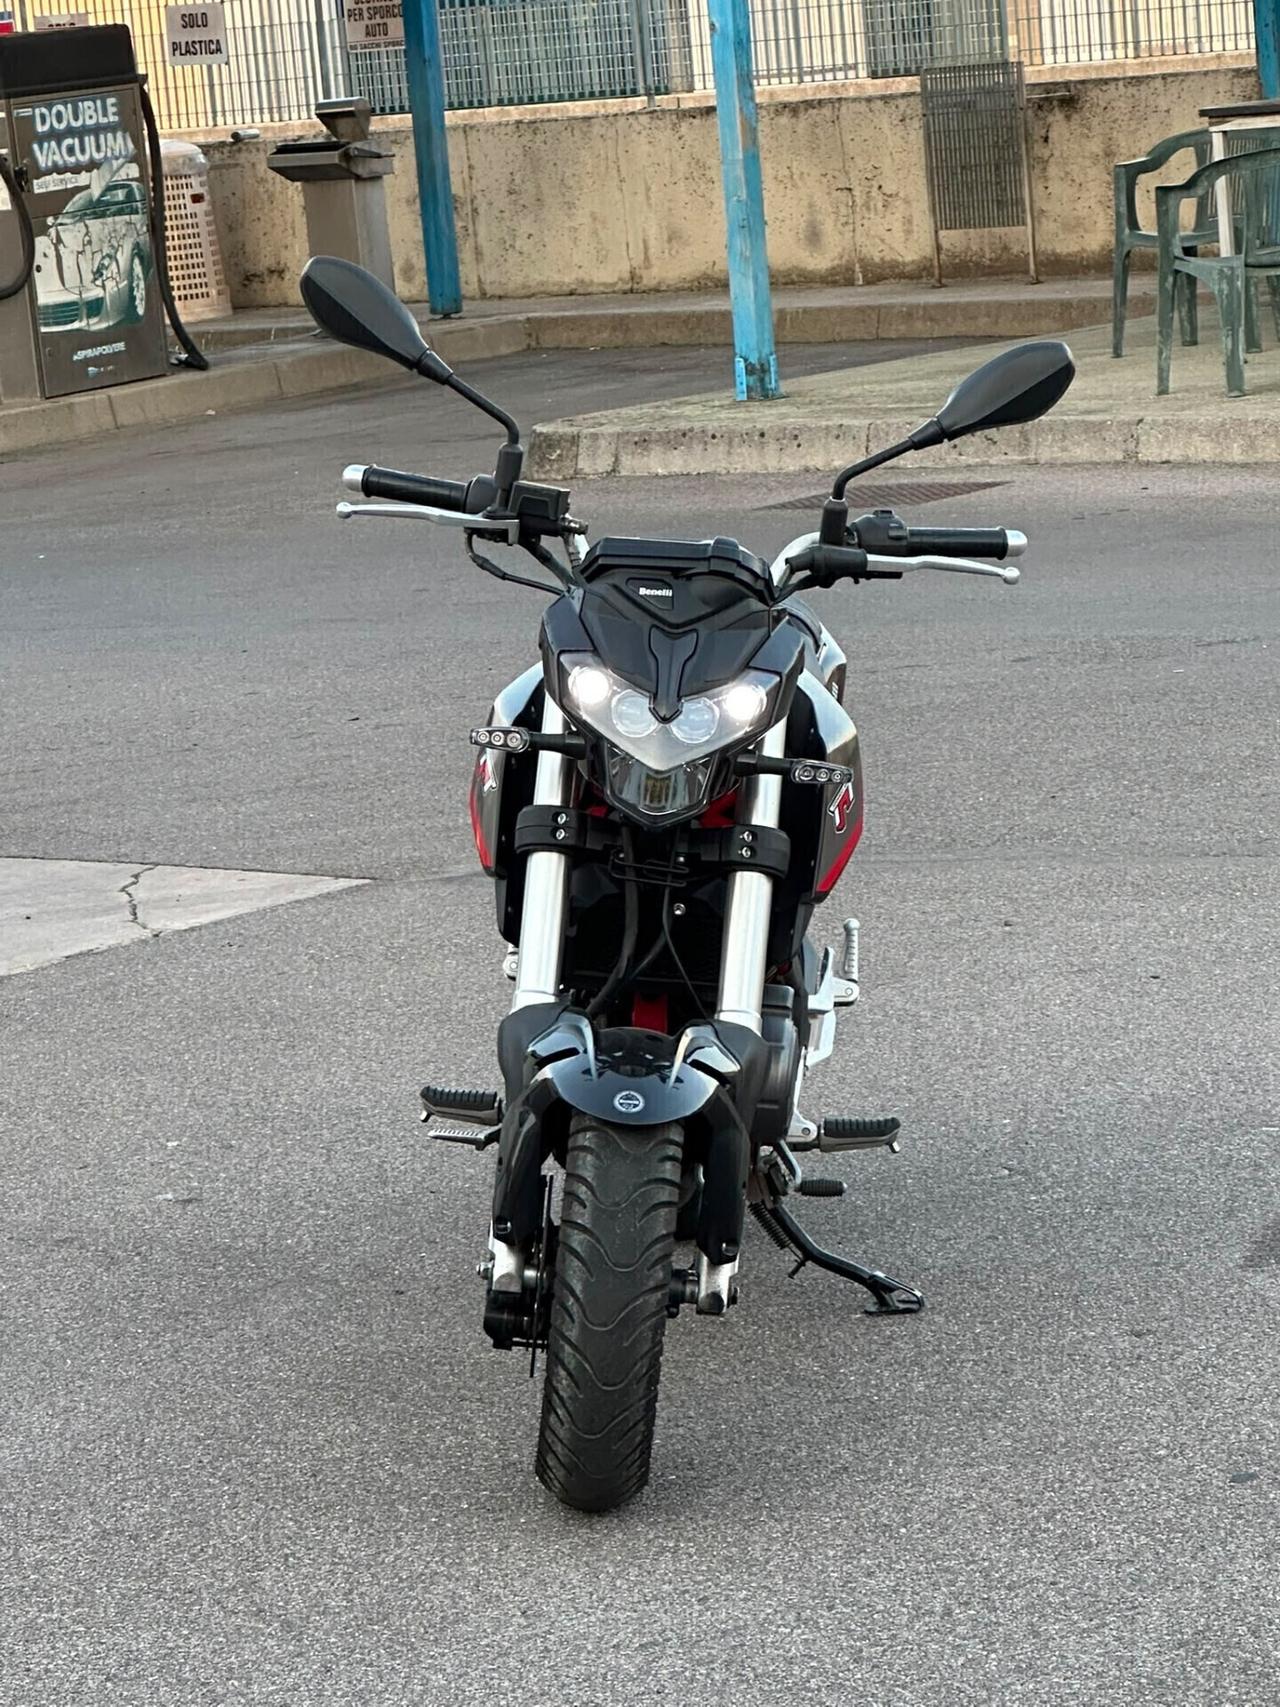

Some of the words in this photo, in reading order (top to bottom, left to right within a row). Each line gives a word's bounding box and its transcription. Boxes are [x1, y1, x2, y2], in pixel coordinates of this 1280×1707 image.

[181, 12, 208, 29] SOLO
[347, 8, 364, 22] PER
[365, 22, 389, 38] AUTO
[172, 39, 223, 56] PLASTICA
[34, 97, 119, 132] DOUBLE
[32, 131, 130, 168] VACUUM
[639, 587, 673, 597] Benelli
